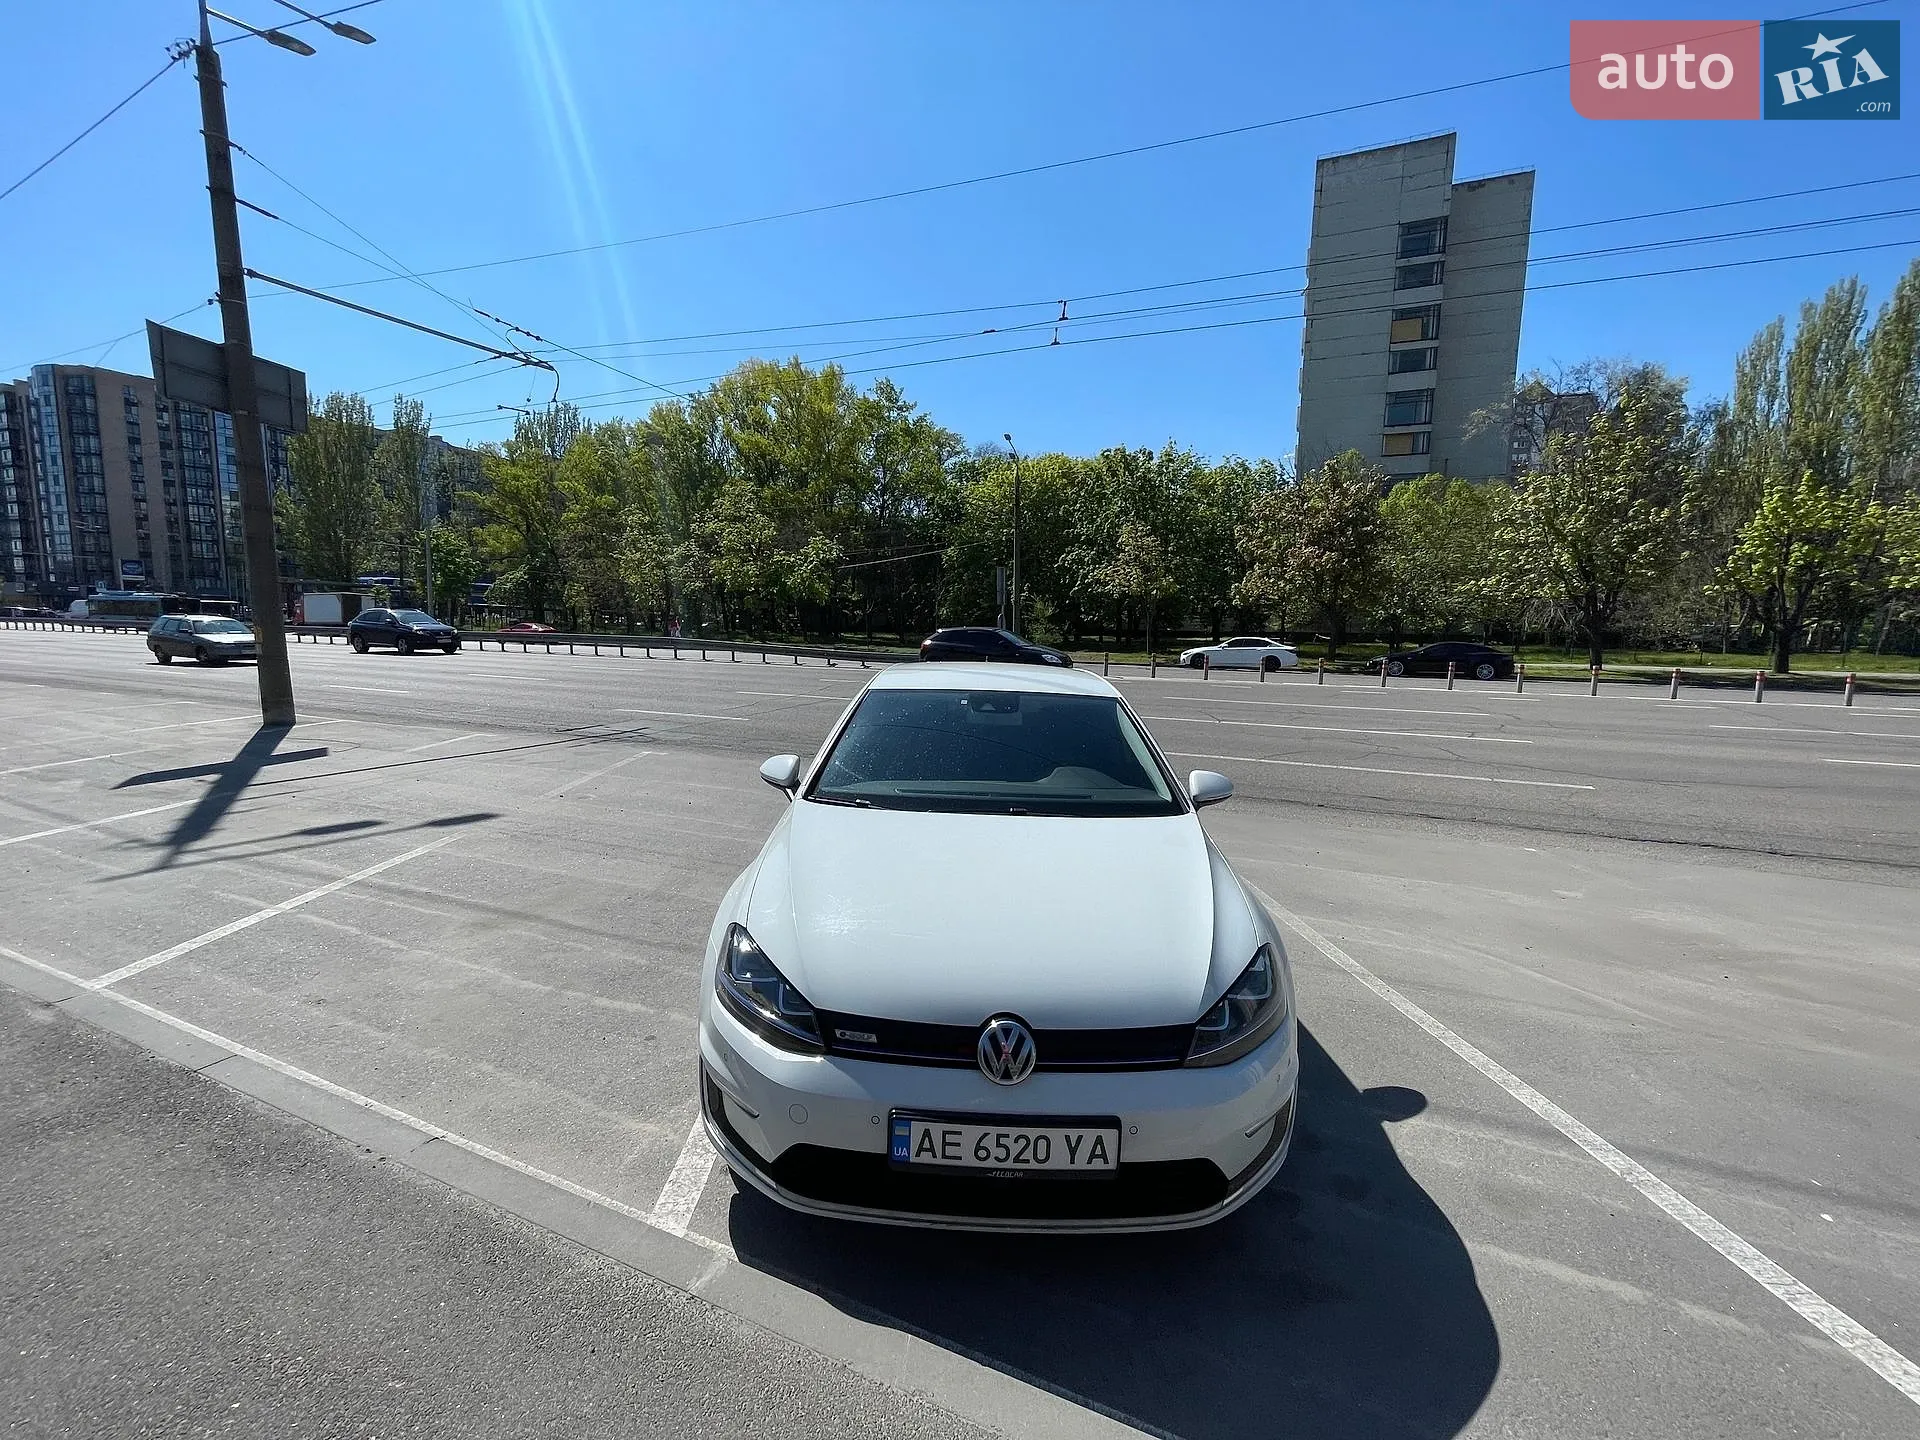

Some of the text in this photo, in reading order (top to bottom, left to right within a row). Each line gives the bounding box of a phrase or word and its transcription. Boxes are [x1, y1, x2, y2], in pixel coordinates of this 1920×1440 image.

[894, 1147, 909, 1157] UA
[914, 1128, 1110, 1165] AE 6520 YA
